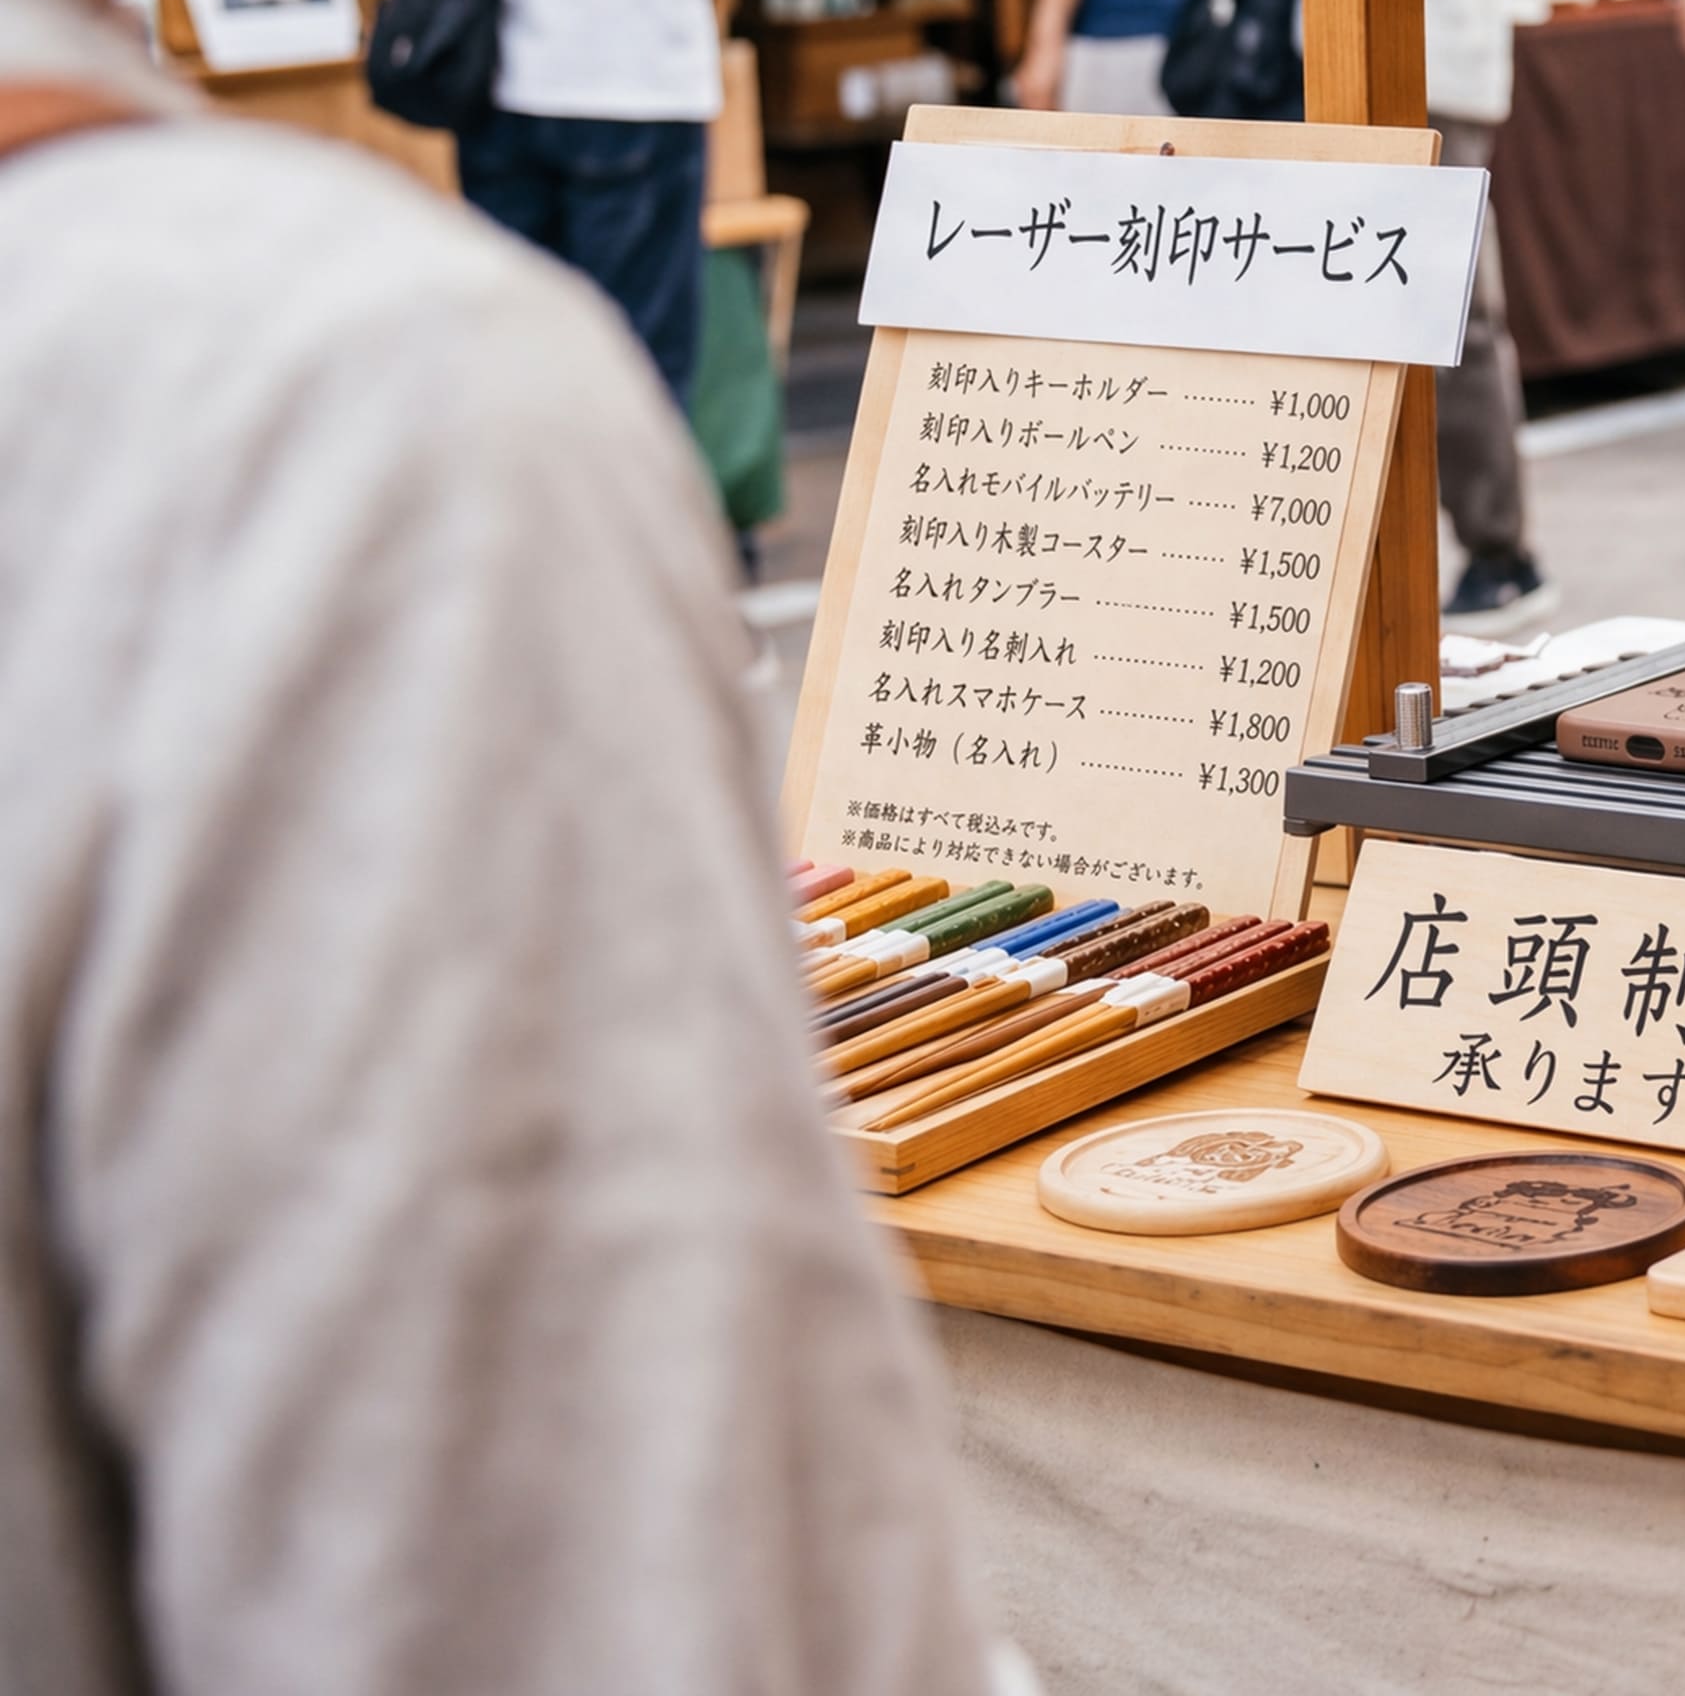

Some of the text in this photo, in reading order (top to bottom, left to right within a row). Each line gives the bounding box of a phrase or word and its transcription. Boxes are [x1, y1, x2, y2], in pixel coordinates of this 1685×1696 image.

[926, 196, 1409, 286] レーザー刻印サービス
[927, 361, 1351, 421] 刻印入りキーホルダー ¥1,000
[919, 411, 1342, 473] 刻印入りボールペン ¥1,200
[909, 462, 1332, 527] 名入れモバイルバッテリー ¥7,000
[899, 514, 1321, 580] 刻印入り木製コースター ¥1,500
[889, 567, 1311, 635] 名入れタンブラー ¥1,500
[879, 619, 1301, 689] 刻印入り名刺入れ ¥1,200
[868, 671, 1291, 743] 名入れスマホケース ¥1,800
[1199, 762, 1280, 797] ¥1,300
